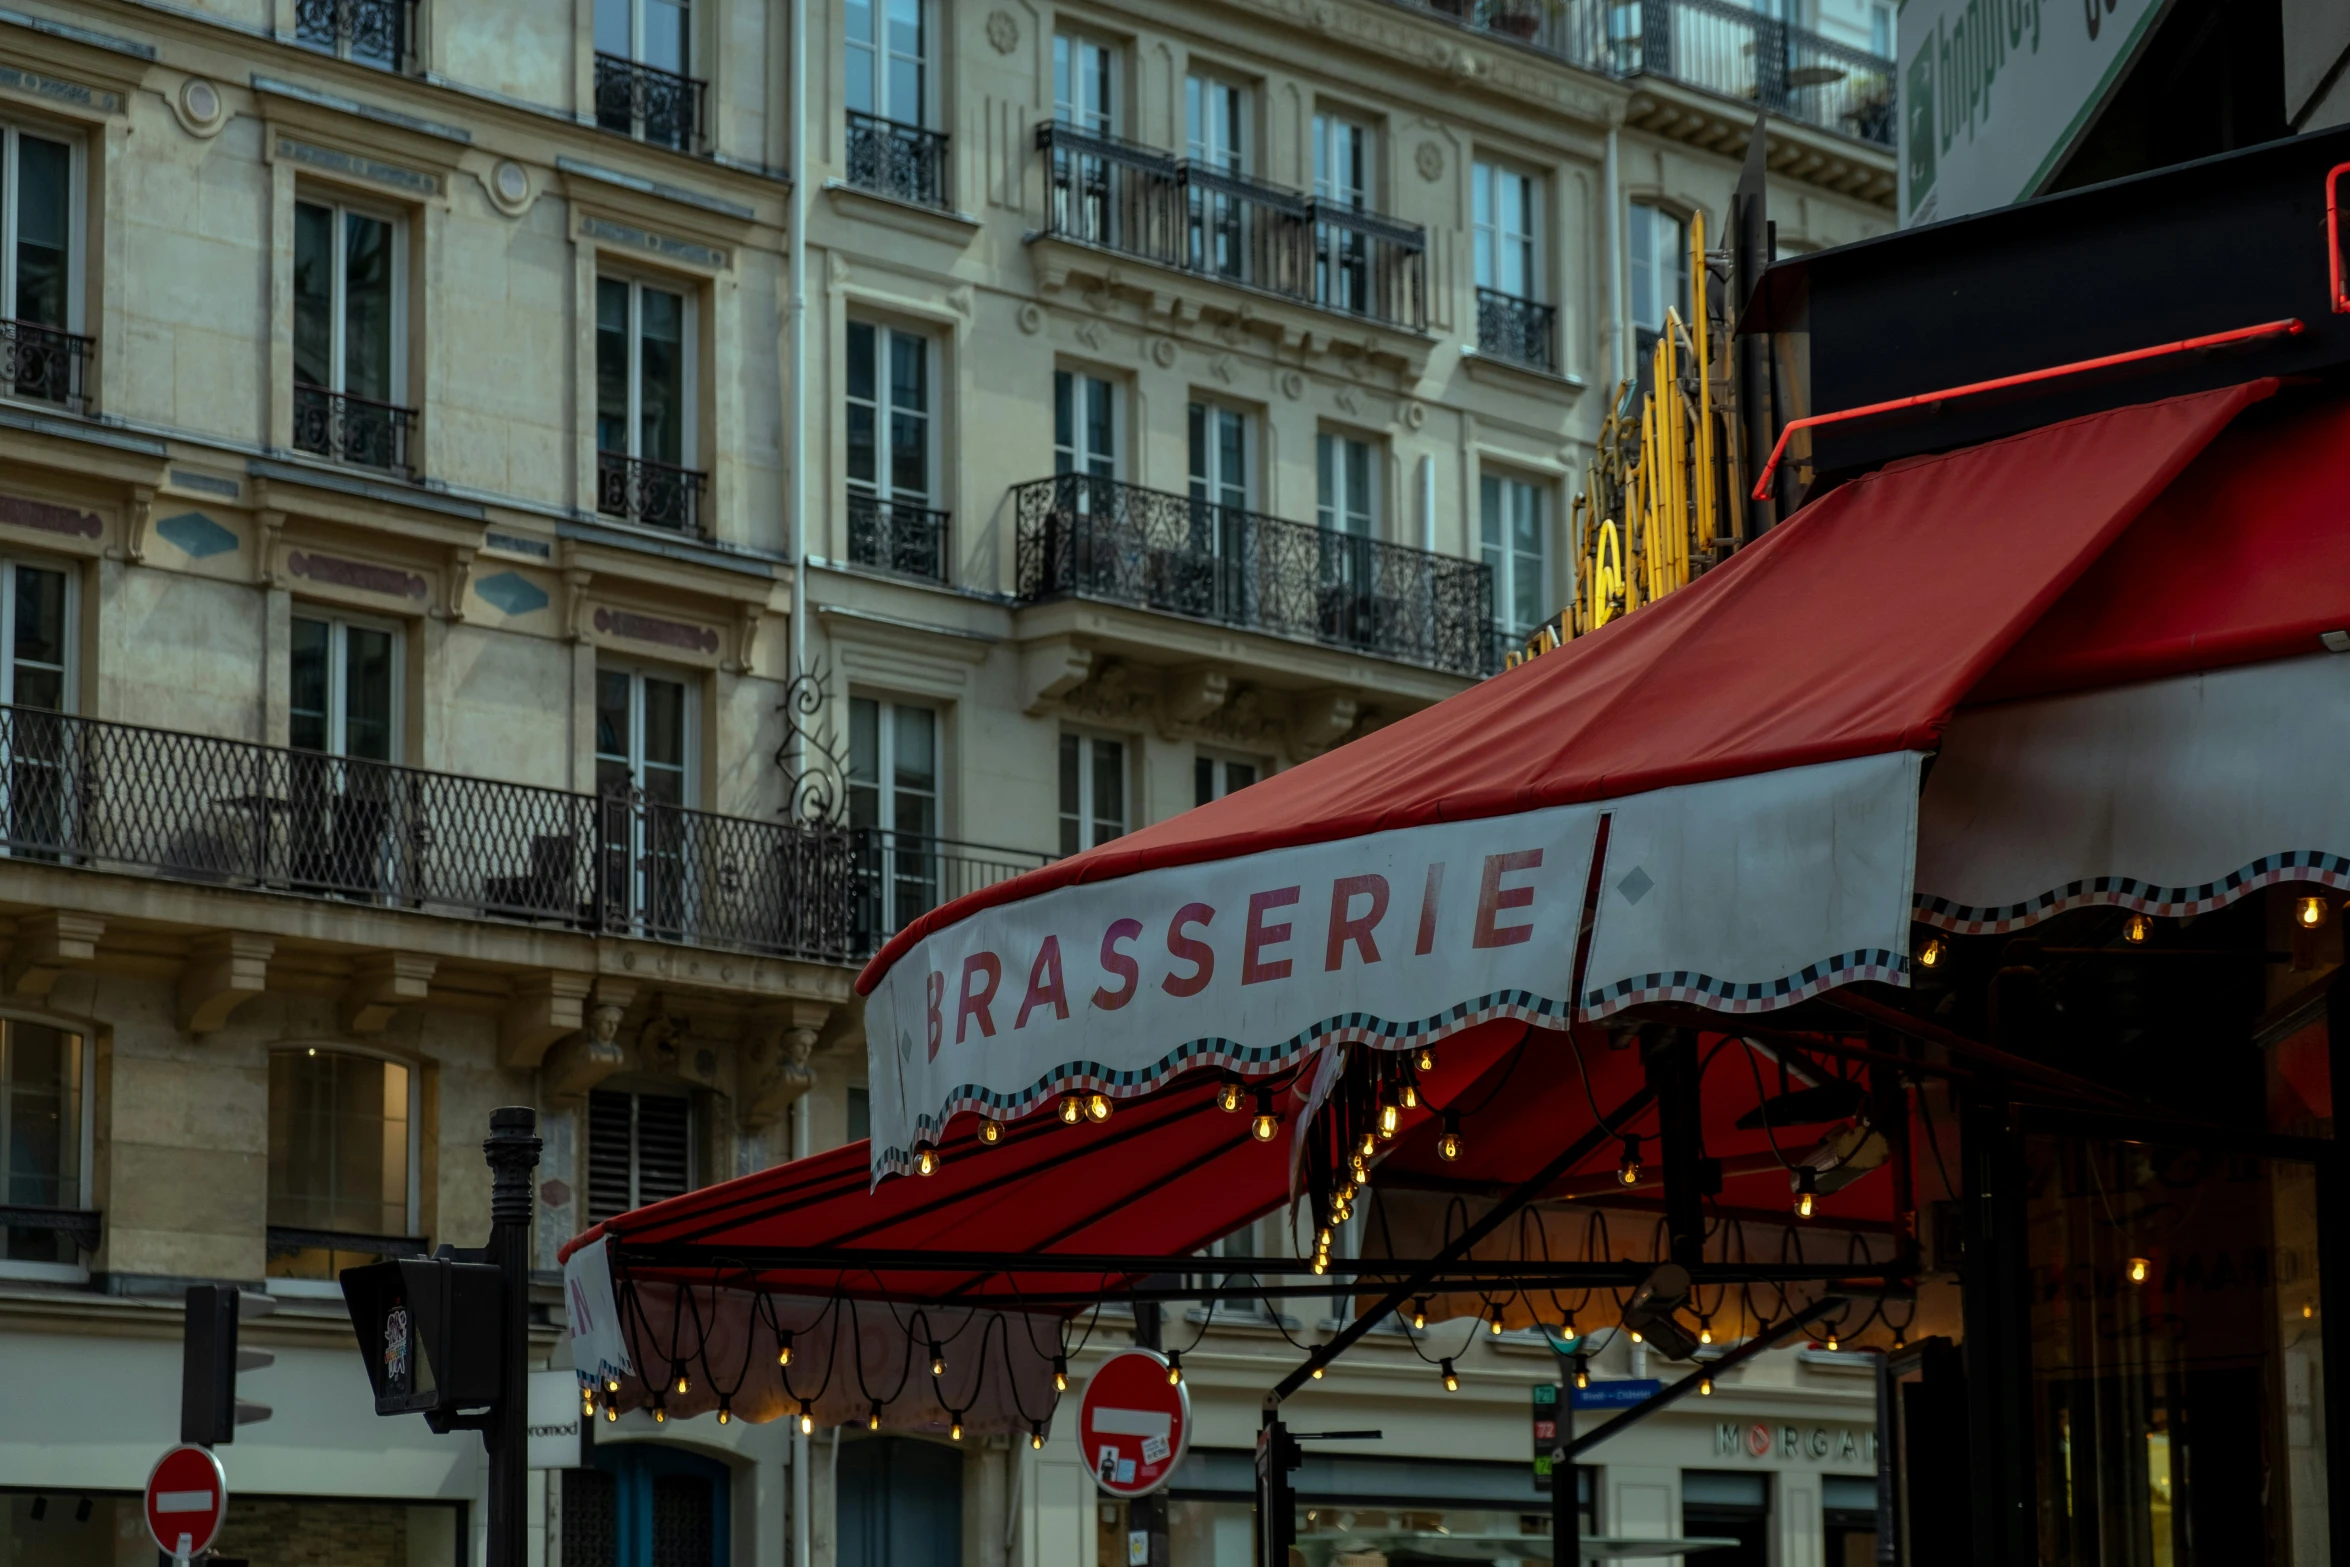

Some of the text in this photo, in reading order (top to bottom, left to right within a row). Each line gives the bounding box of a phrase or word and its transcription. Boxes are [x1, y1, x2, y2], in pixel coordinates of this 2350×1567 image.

[926, 848, 1543, 1064] BRASSERIE
[528, 1421, 578, 1437] romod
[1539, 1423, 1554, 1438] 72
